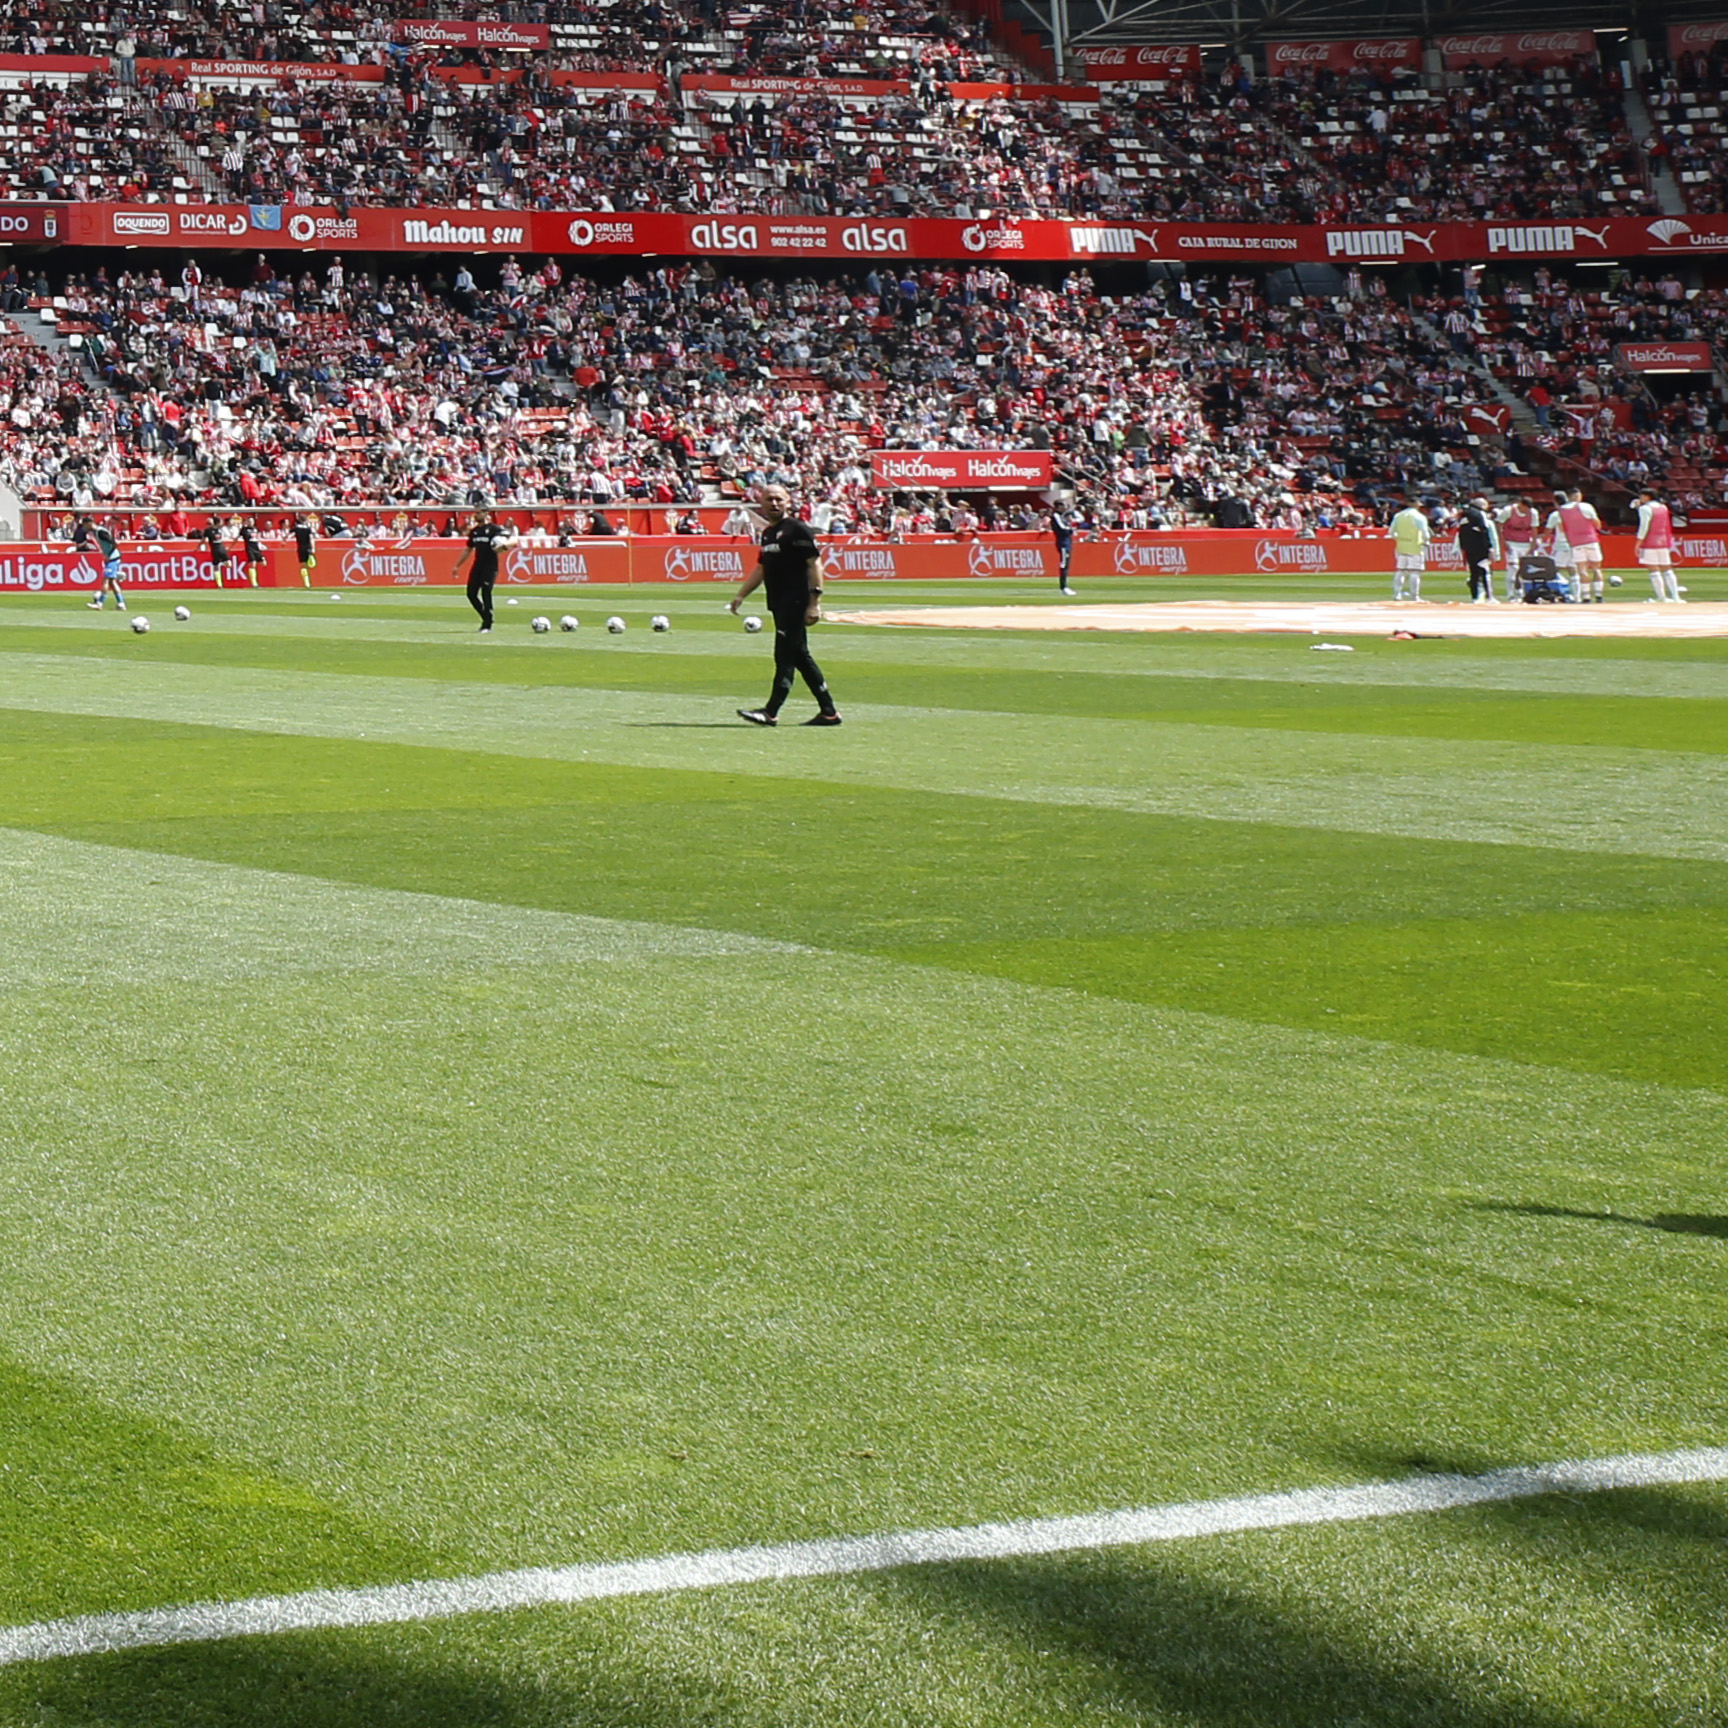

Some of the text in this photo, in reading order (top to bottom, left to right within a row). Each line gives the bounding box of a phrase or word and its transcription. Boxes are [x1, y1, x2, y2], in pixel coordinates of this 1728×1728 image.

[191, 62, 212, 73] Real
[214, 63, 269, 75] SPORTING
[271, 64, 284, 75] de
[731, 79, 750, 89] Real
[751, 79, 801, 90] SPORTING
[117, 217, 166, 231] OQUENDO
[180, 213, 227, 229] DICAR
[316, 218, 357, 230] ORLEGI
[594, 222, 633, 234] ORLEGI
[770, 225, 827, 235] www.alsa.es
[317, 228, 358, 240] SPORTS
[404, 220, 523, 245] Mahou SIN
[595, 232, 634, 244] SPORTS
[692, 219, 907, 251] alsa alsa
[771, 237, 787, 247] 902
[1070, 227, 1136, 253] PUMA
[1488, 226, 1574, 252] PUMA
[987, 239, 1024, 249] SPORTS
[1179, 236, 1205, 249] CAJA
[1206, 237, 1243, 249] RURAL
[1245, 238, 1260, 249] DE
[1326, 230, 1404, 256] PUMA
[691, 552, 743, 572] INTEGRA
[844, 550, 894, 570] INTEGRA
[994, 549, 1043, 569] INTEGRA
[1139, 547, 1186, 566] INTEGRA
[1279, 545, 1326, 564] INTEGRA
[118, 556, 248, 583] martBank
[370, 555, 424, 576] INTEGRA
[533, 554, 587, 575] INTEGRA
